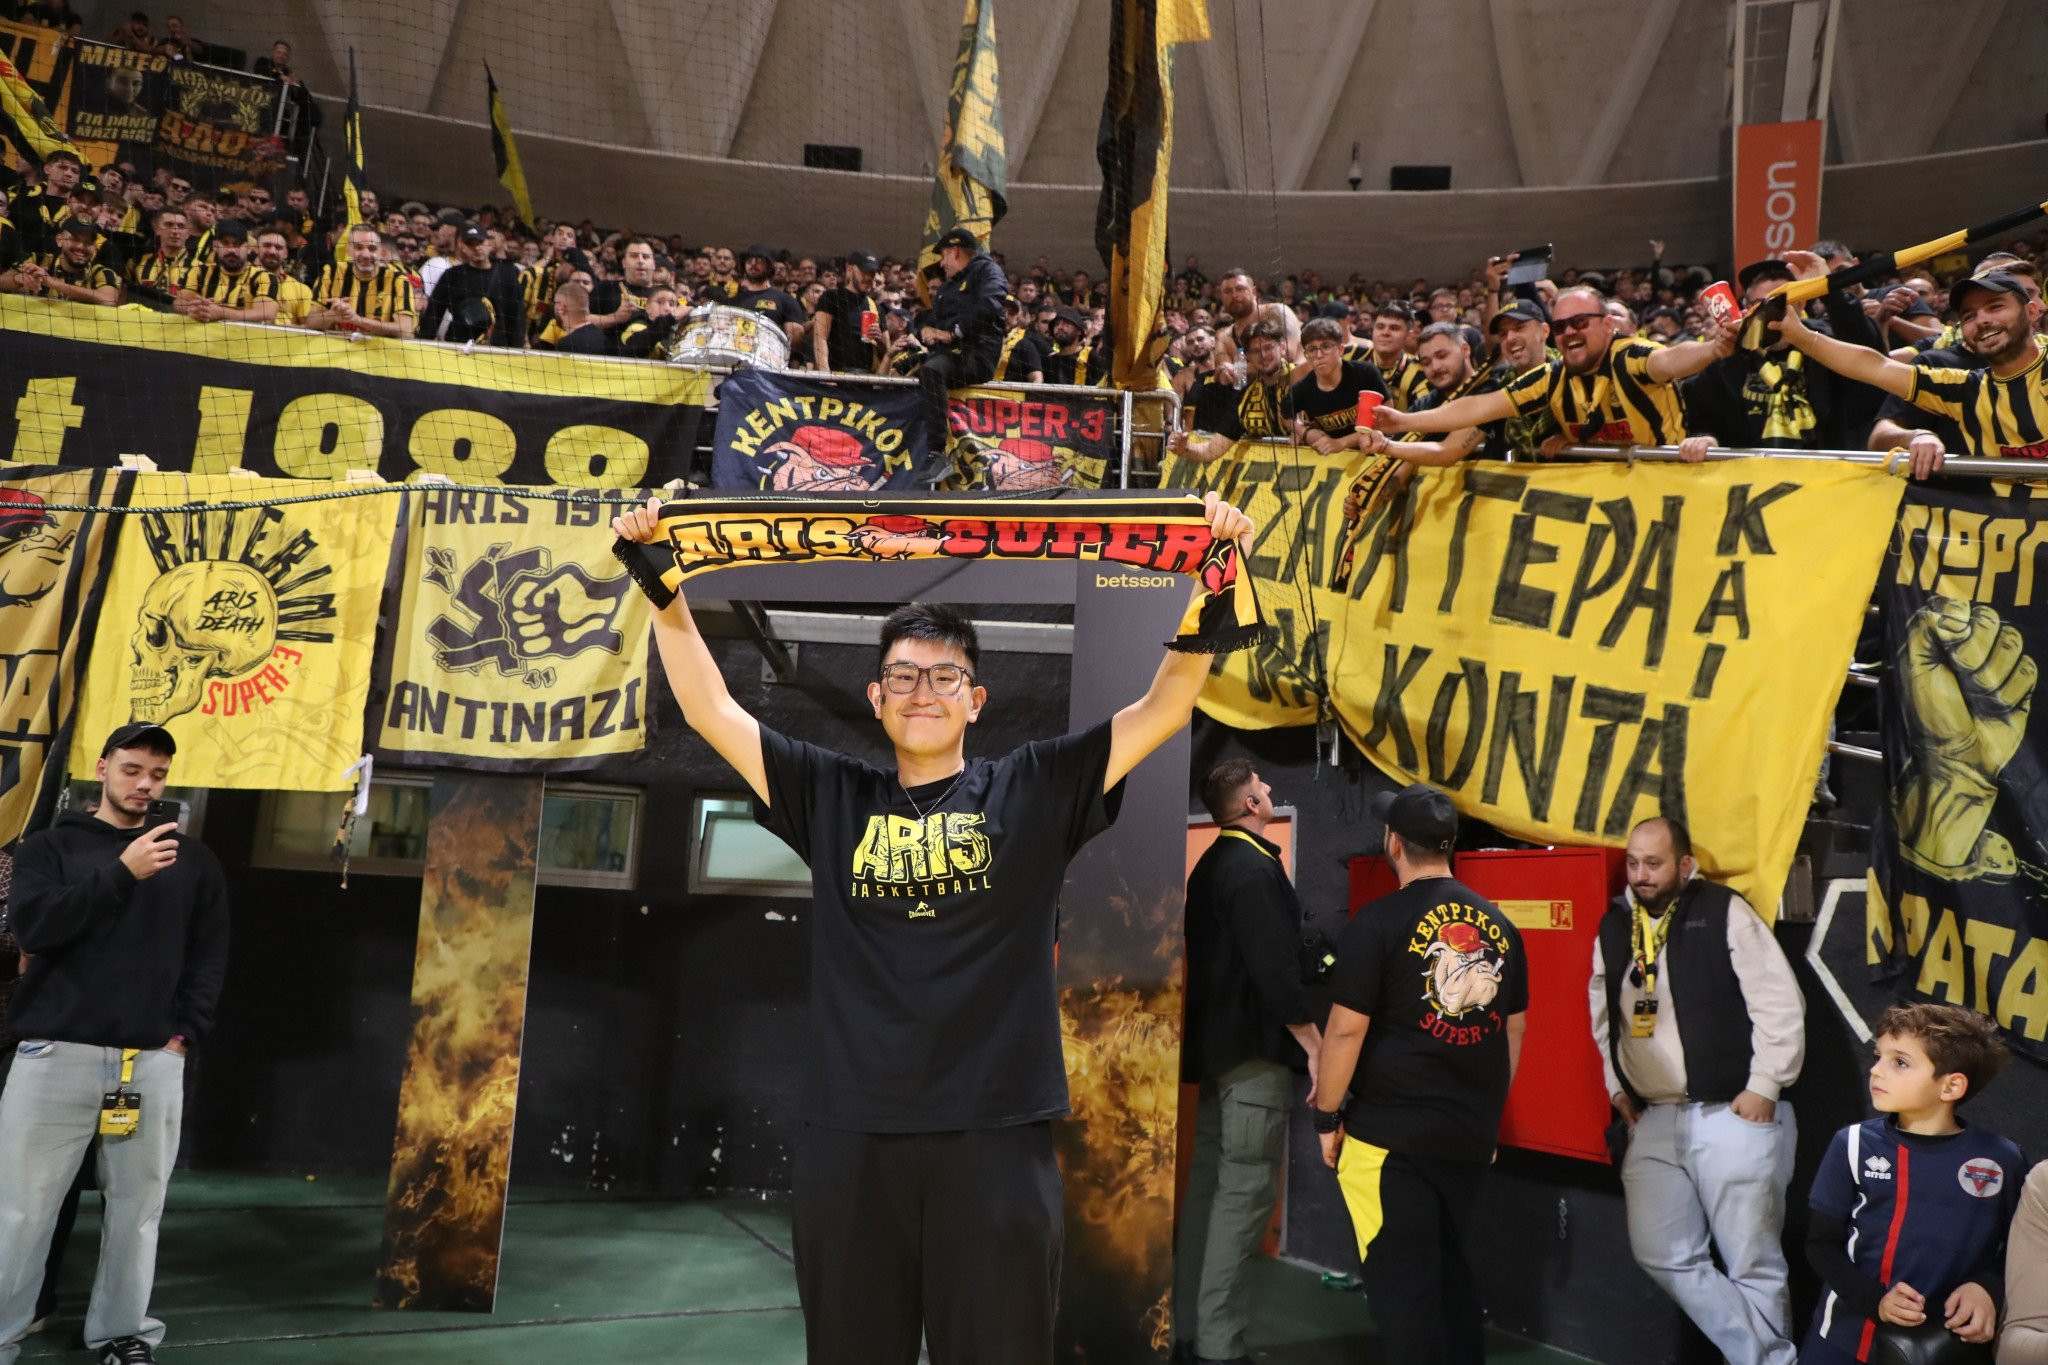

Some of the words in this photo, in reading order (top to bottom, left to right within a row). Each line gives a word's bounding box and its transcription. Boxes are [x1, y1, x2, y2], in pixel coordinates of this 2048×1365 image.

[730, 396, 913, 476] ΚΕΝΤΡΙΚΟΣ
[421, 486, 531, 528] ARIS
[669, 517, 858, 573] ARIS
[204, 590, 258, 611] ARIS
[1096, 573, 1175, 588] betsson
[195, 615, 265, 632] DEATH
[387, 677, 642, 744] ANTINAZI
[1364, 644, 1691, 838] ΚΟΝΤΑ
[852, 811, 993, 884] ARIS
[852, 875, 992, 898] BASKETBALL
[1408, 902, 1510, 957] ΚΕΝΤΡΙΚΟΣ
[1864, 1170, 1892, 1180] errea
